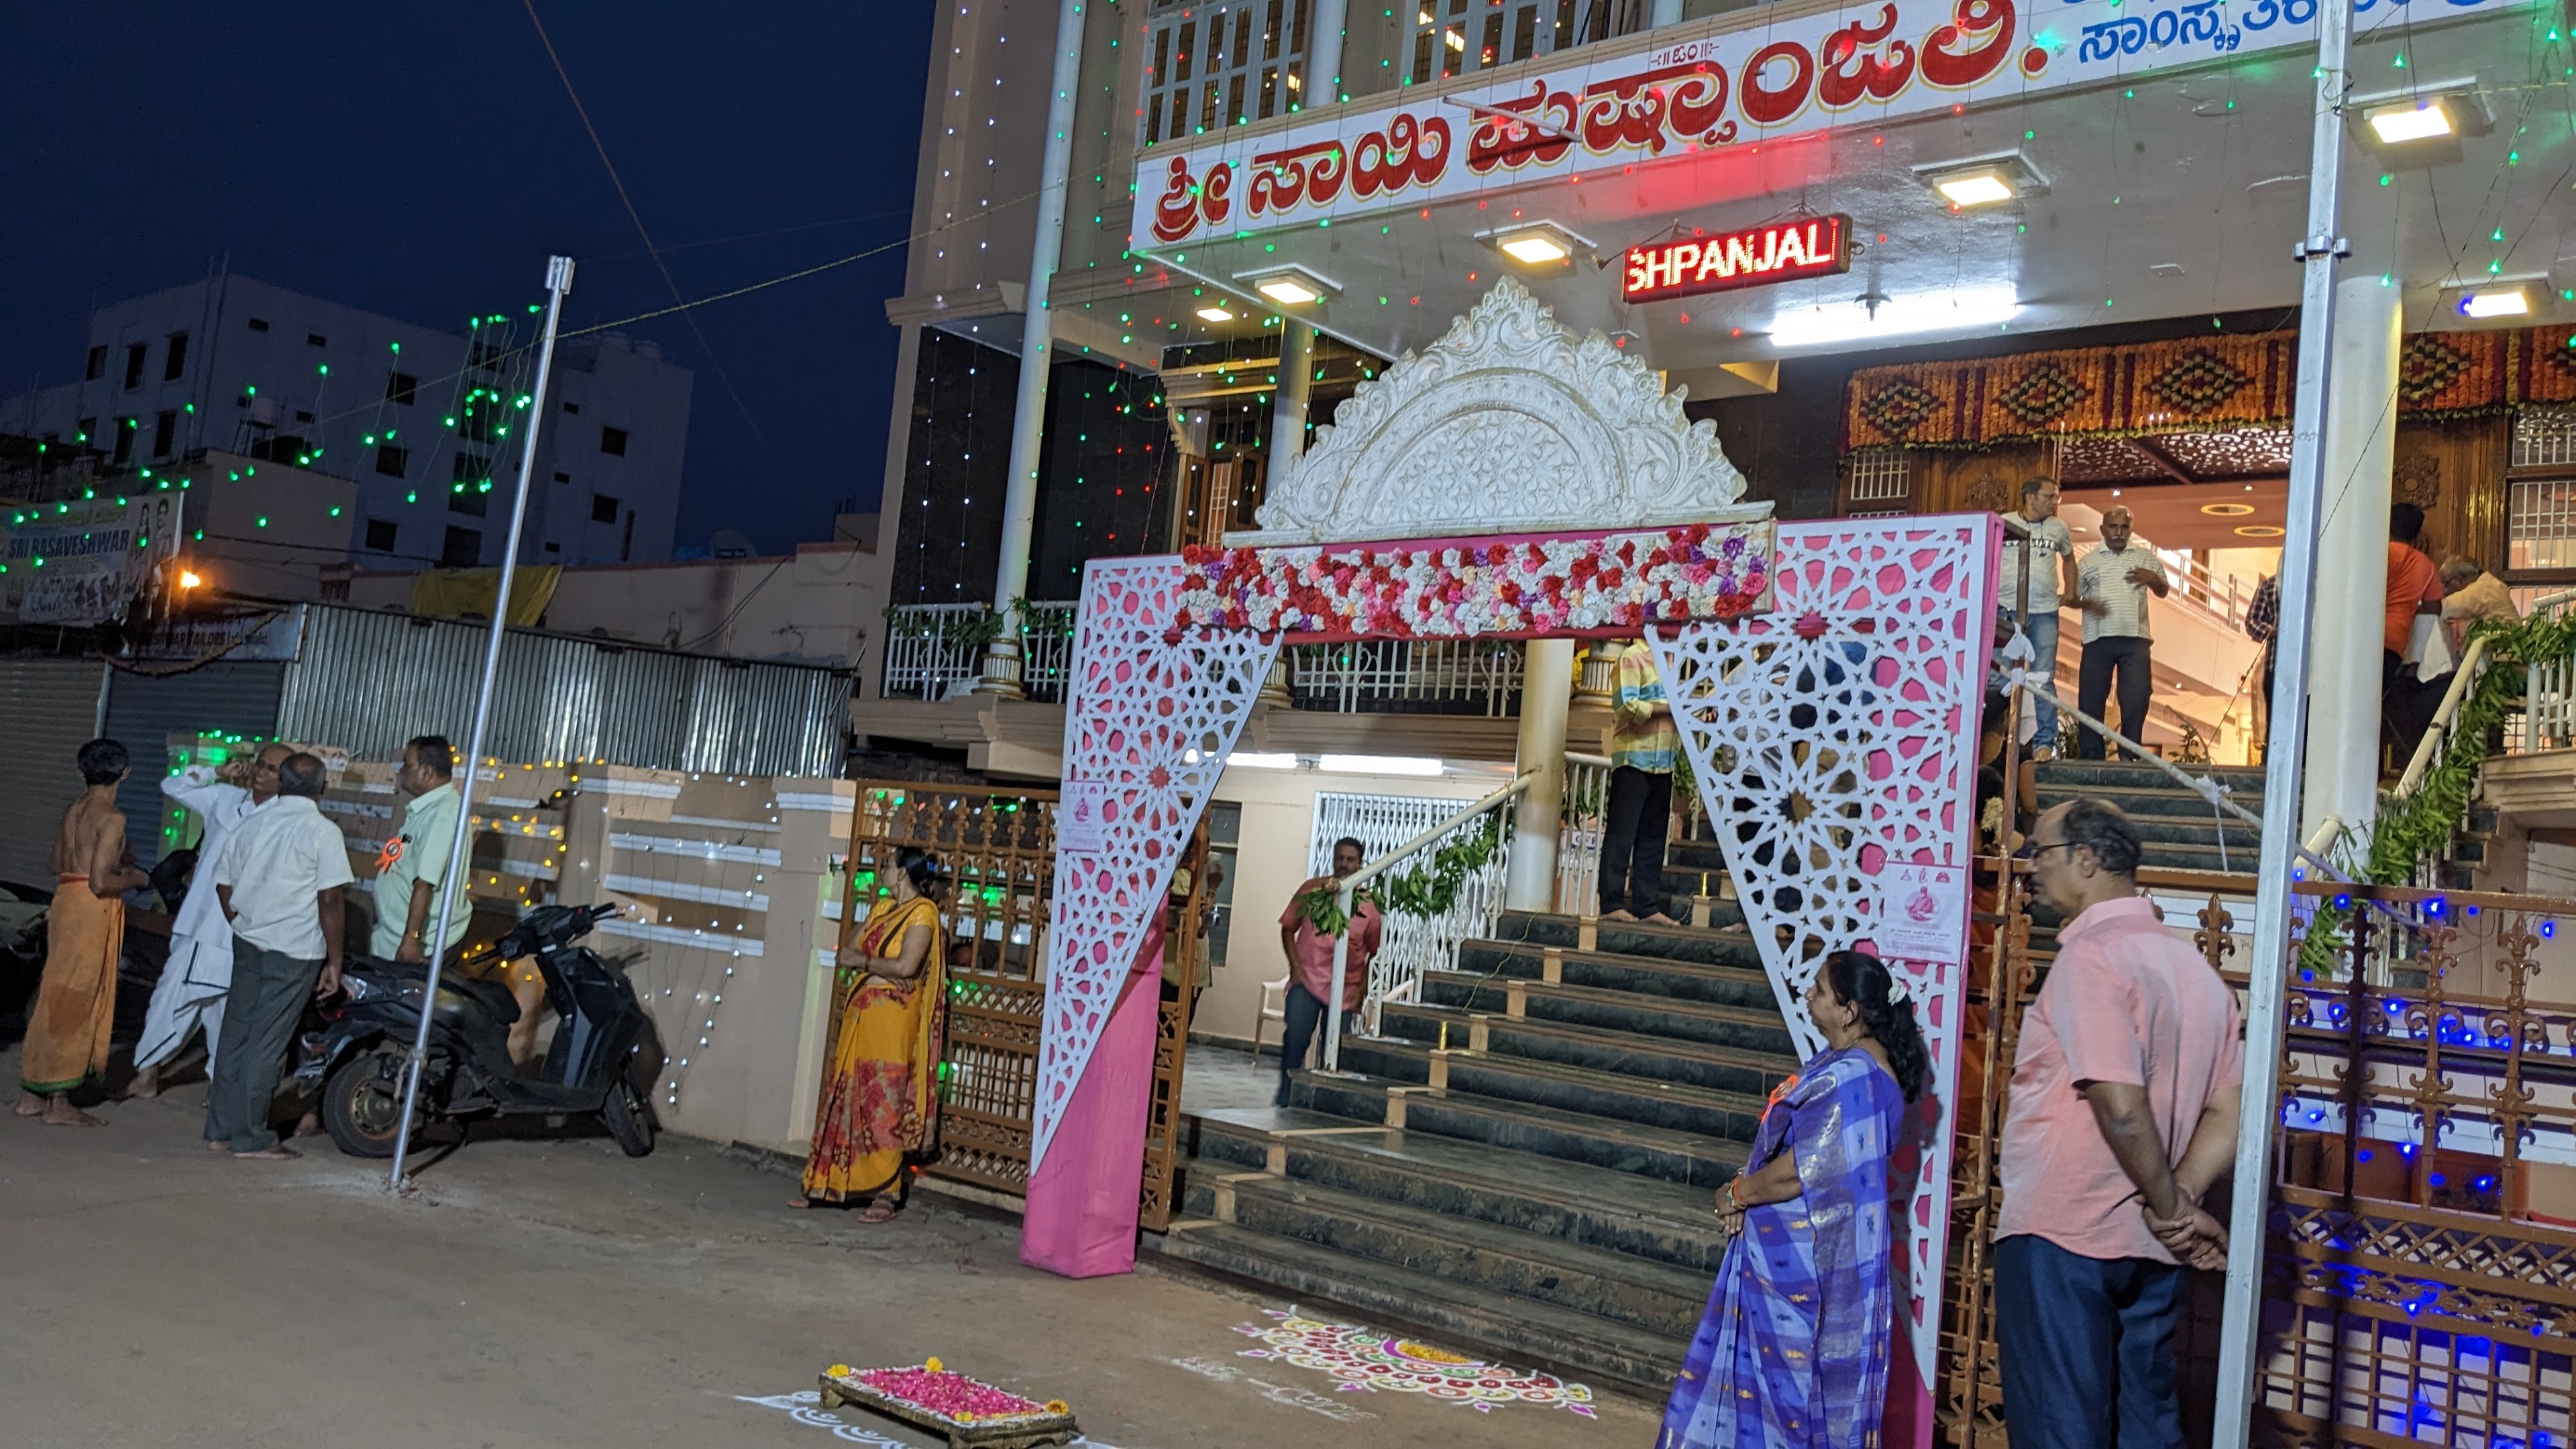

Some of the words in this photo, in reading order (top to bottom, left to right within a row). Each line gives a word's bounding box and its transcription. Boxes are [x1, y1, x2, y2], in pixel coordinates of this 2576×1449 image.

[1150, 156, 1233, 244] ಶ್ರೀ
[1246, 113, 1452, 218] ಸಾಯಿ
[9, 537, 29, 559] SRI
